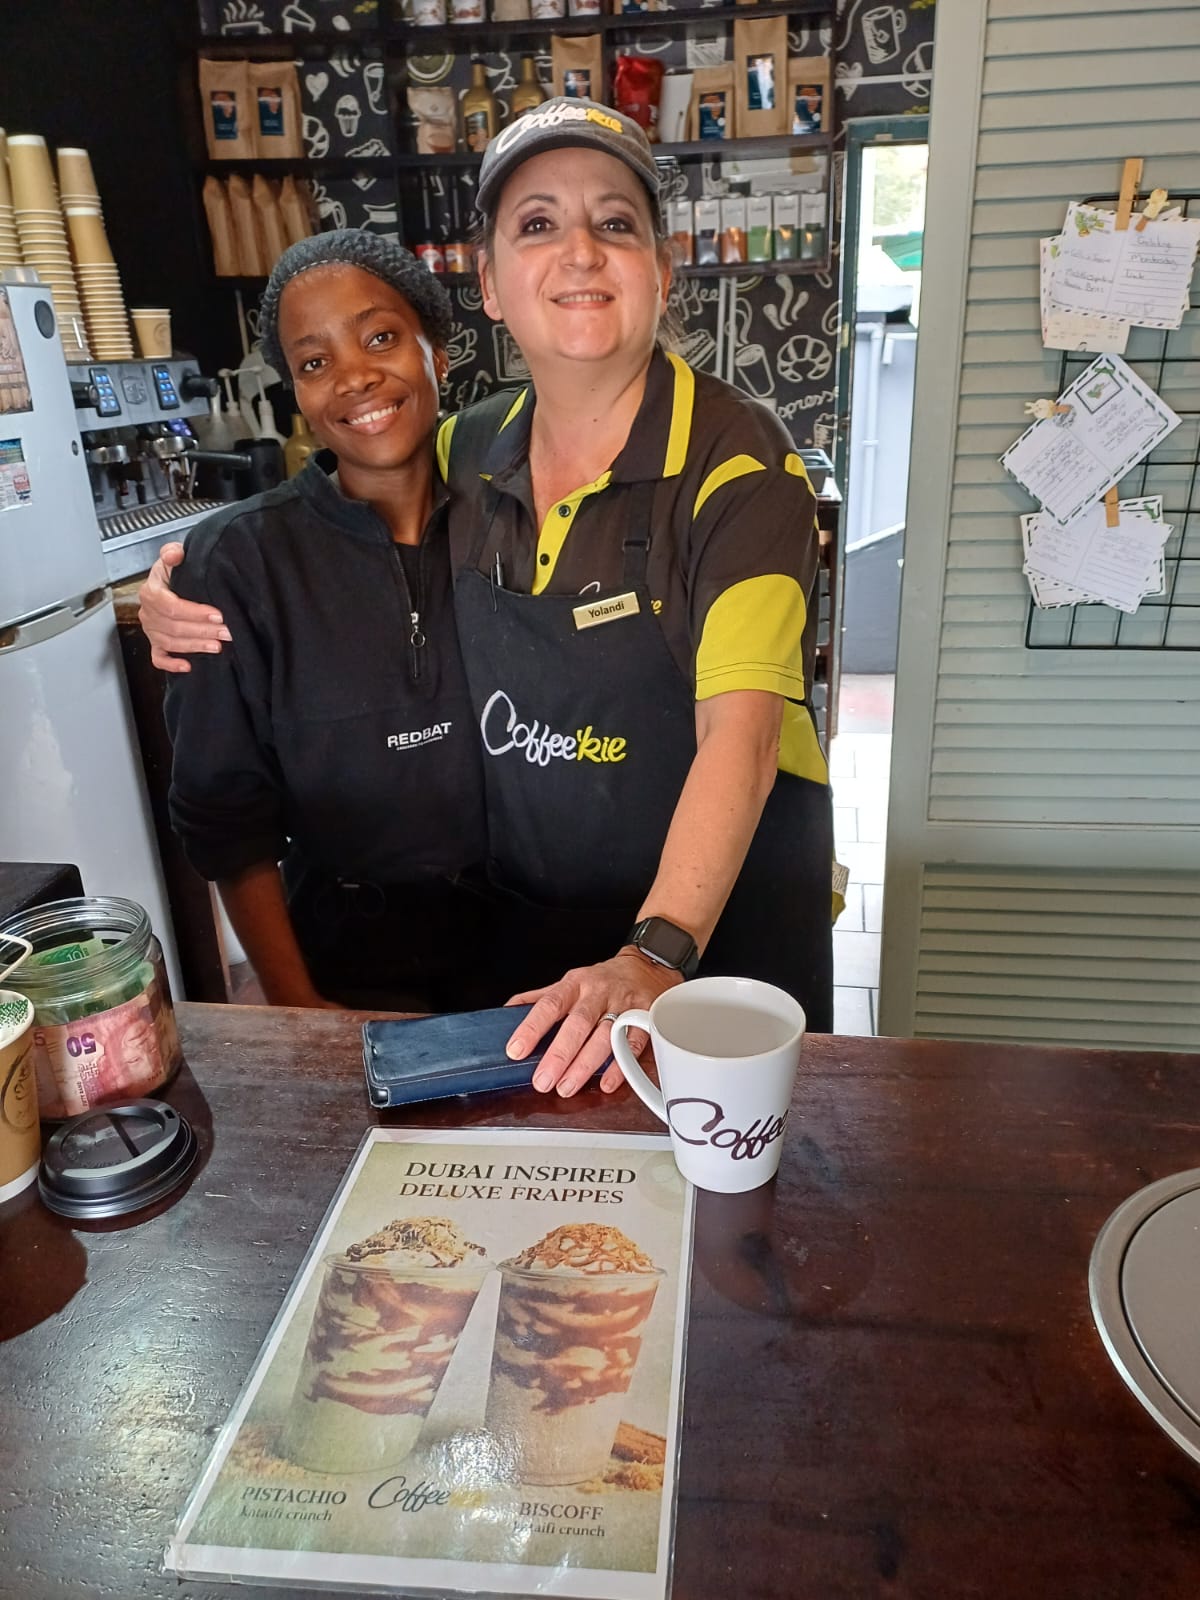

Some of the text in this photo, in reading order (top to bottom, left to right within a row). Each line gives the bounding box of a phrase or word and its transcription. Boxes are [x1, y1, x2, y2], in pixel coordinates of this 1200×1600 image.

[668, 278, 720, 321] offee
[588, 601, 625, 618] Yolandi
[387, 722, 452, 748] REDBAT
[66, 1032, 97, 1058] 50
[404, 1162, 637, 1185] DUBAI INSPIRED
[399, 1182, 625, 1204] DELUXE FRAPPES
[240, 1486, 347, 1505] PISTACHIO
[286, 1509, 333, 1521] crunch
[519, 1502, 604, 1520] BISCOFF
[558, 1525, 606, 1537] crunch
